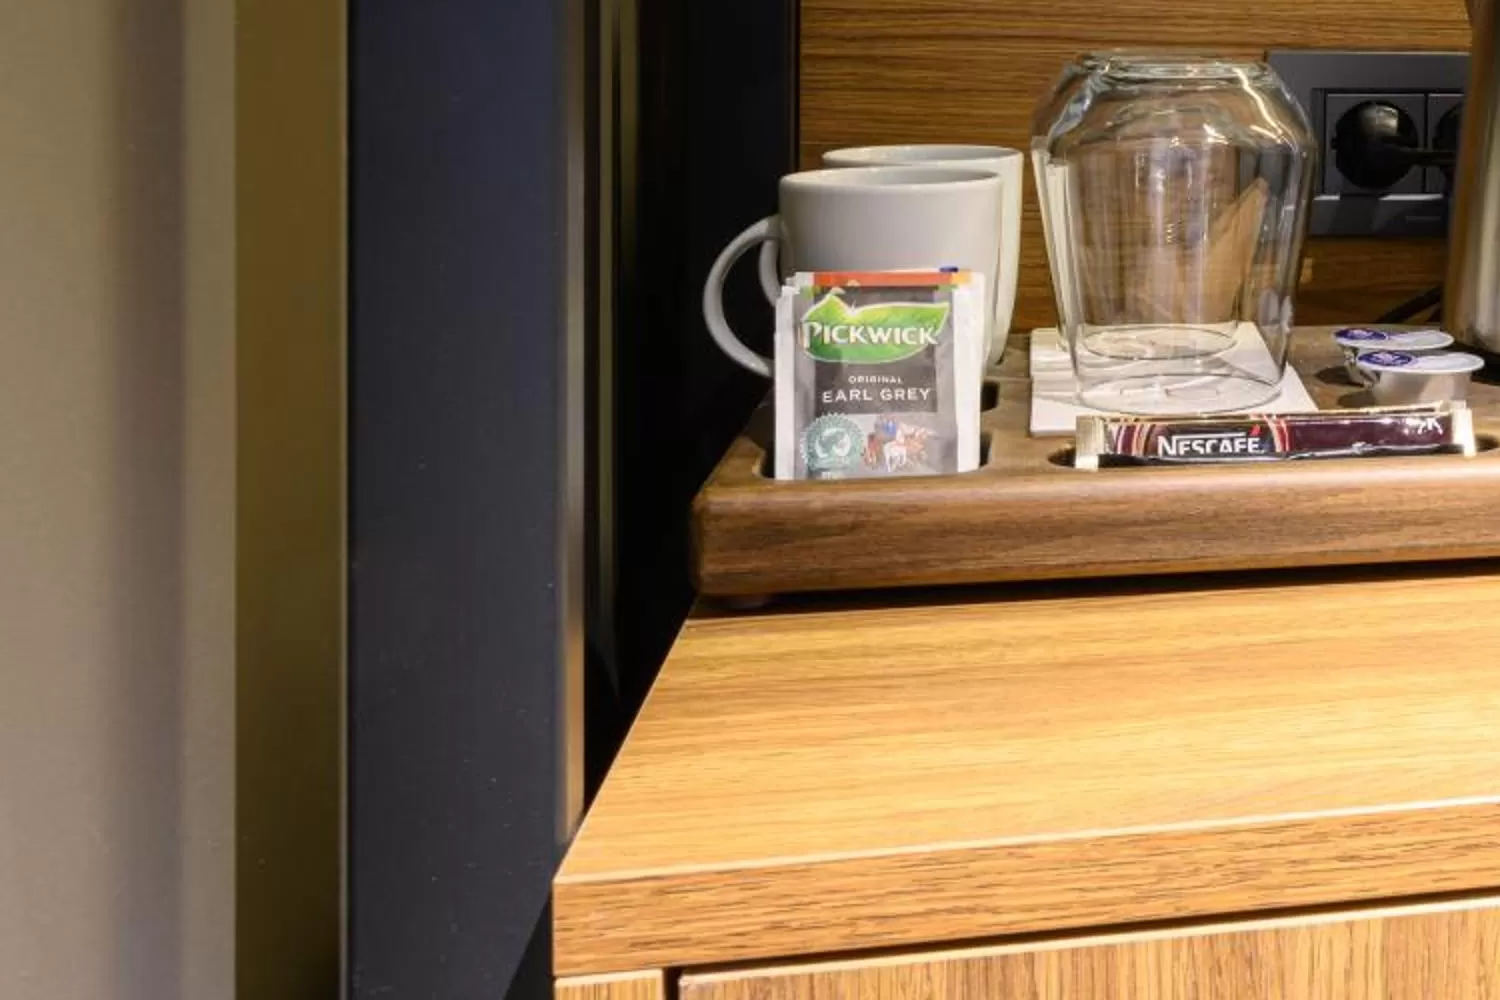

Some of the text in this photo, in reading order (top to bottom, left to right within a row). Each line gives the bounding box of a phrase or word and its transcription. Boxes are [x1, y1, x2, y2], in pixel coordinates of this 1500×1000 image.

[804, 321, 939, 348] PICKWICK
[847, 375, 904, 385] ORIGINAL
[822, 387, 932, 403] EARL GREY
